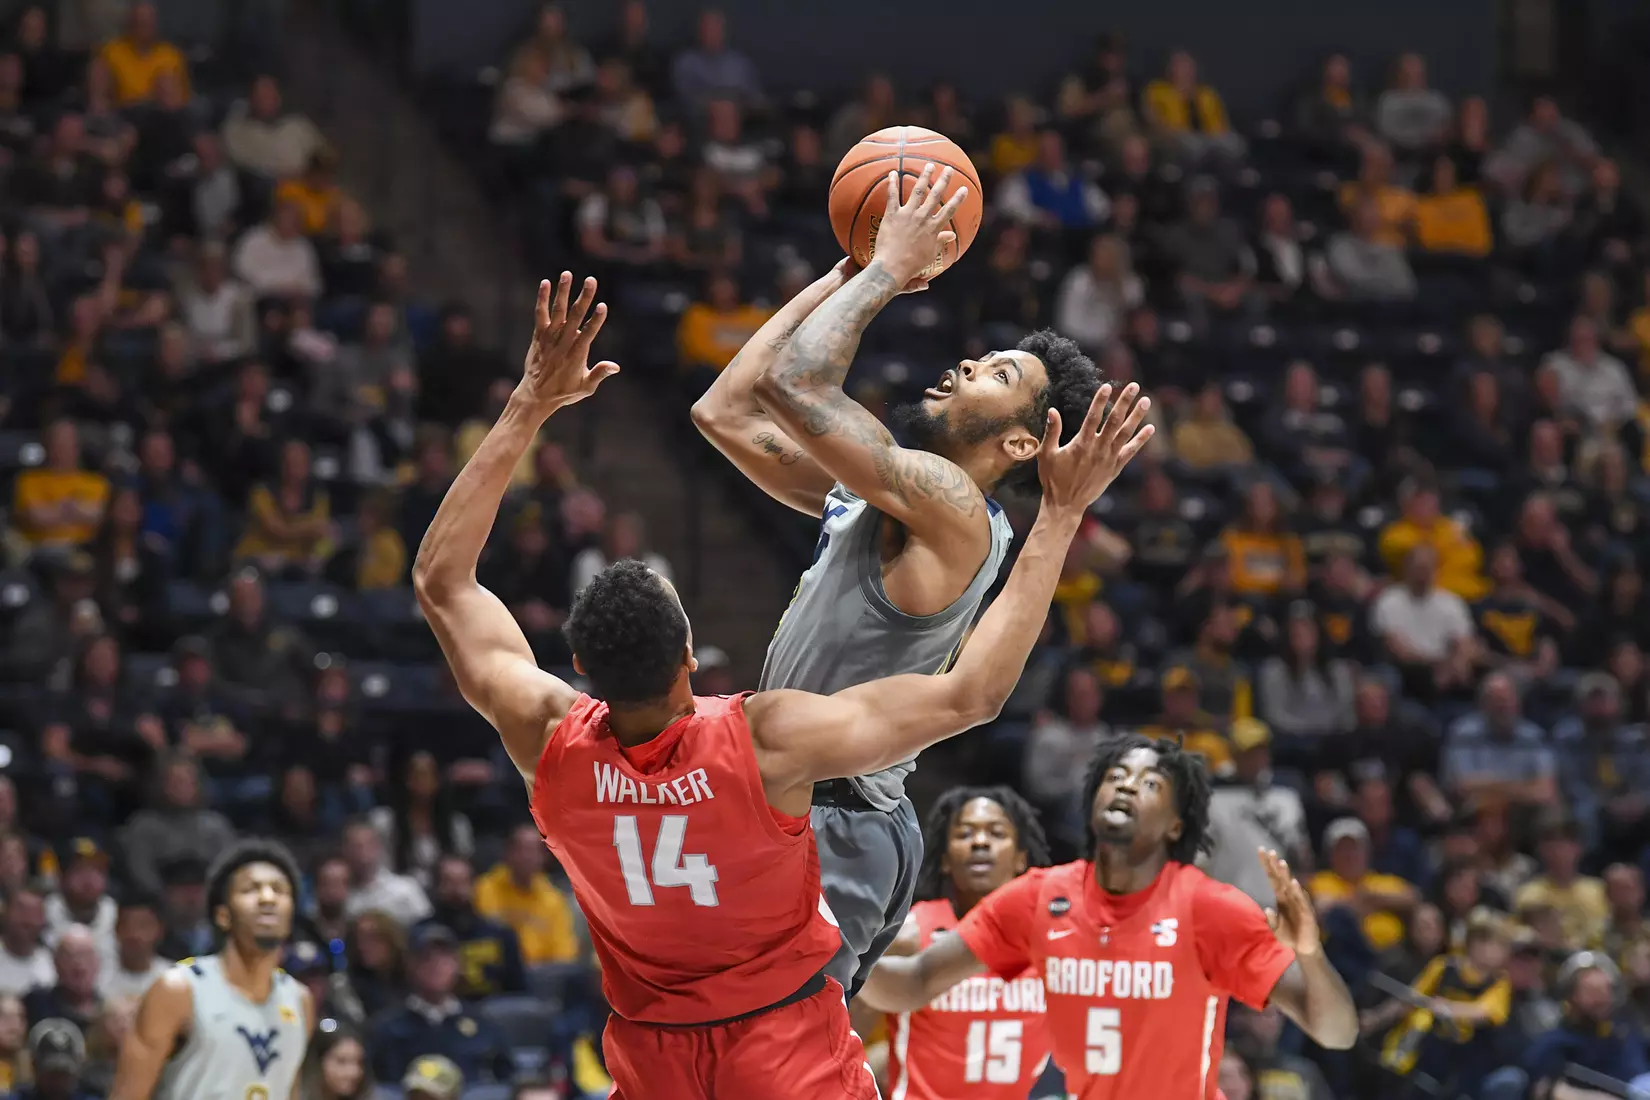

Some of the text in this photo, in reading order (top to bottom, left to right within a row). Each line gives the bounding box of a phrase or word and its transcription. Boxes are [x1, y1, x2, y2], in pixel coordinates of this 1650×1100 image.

[593, 761, 715, 806] WALKER
[613, 815, 720, 907] 14
[1046, 957, 1174, 999] RADFORD
[964, 1019, 1023, 1084] 15
[1085, 1006, 1122, 1075] 5
